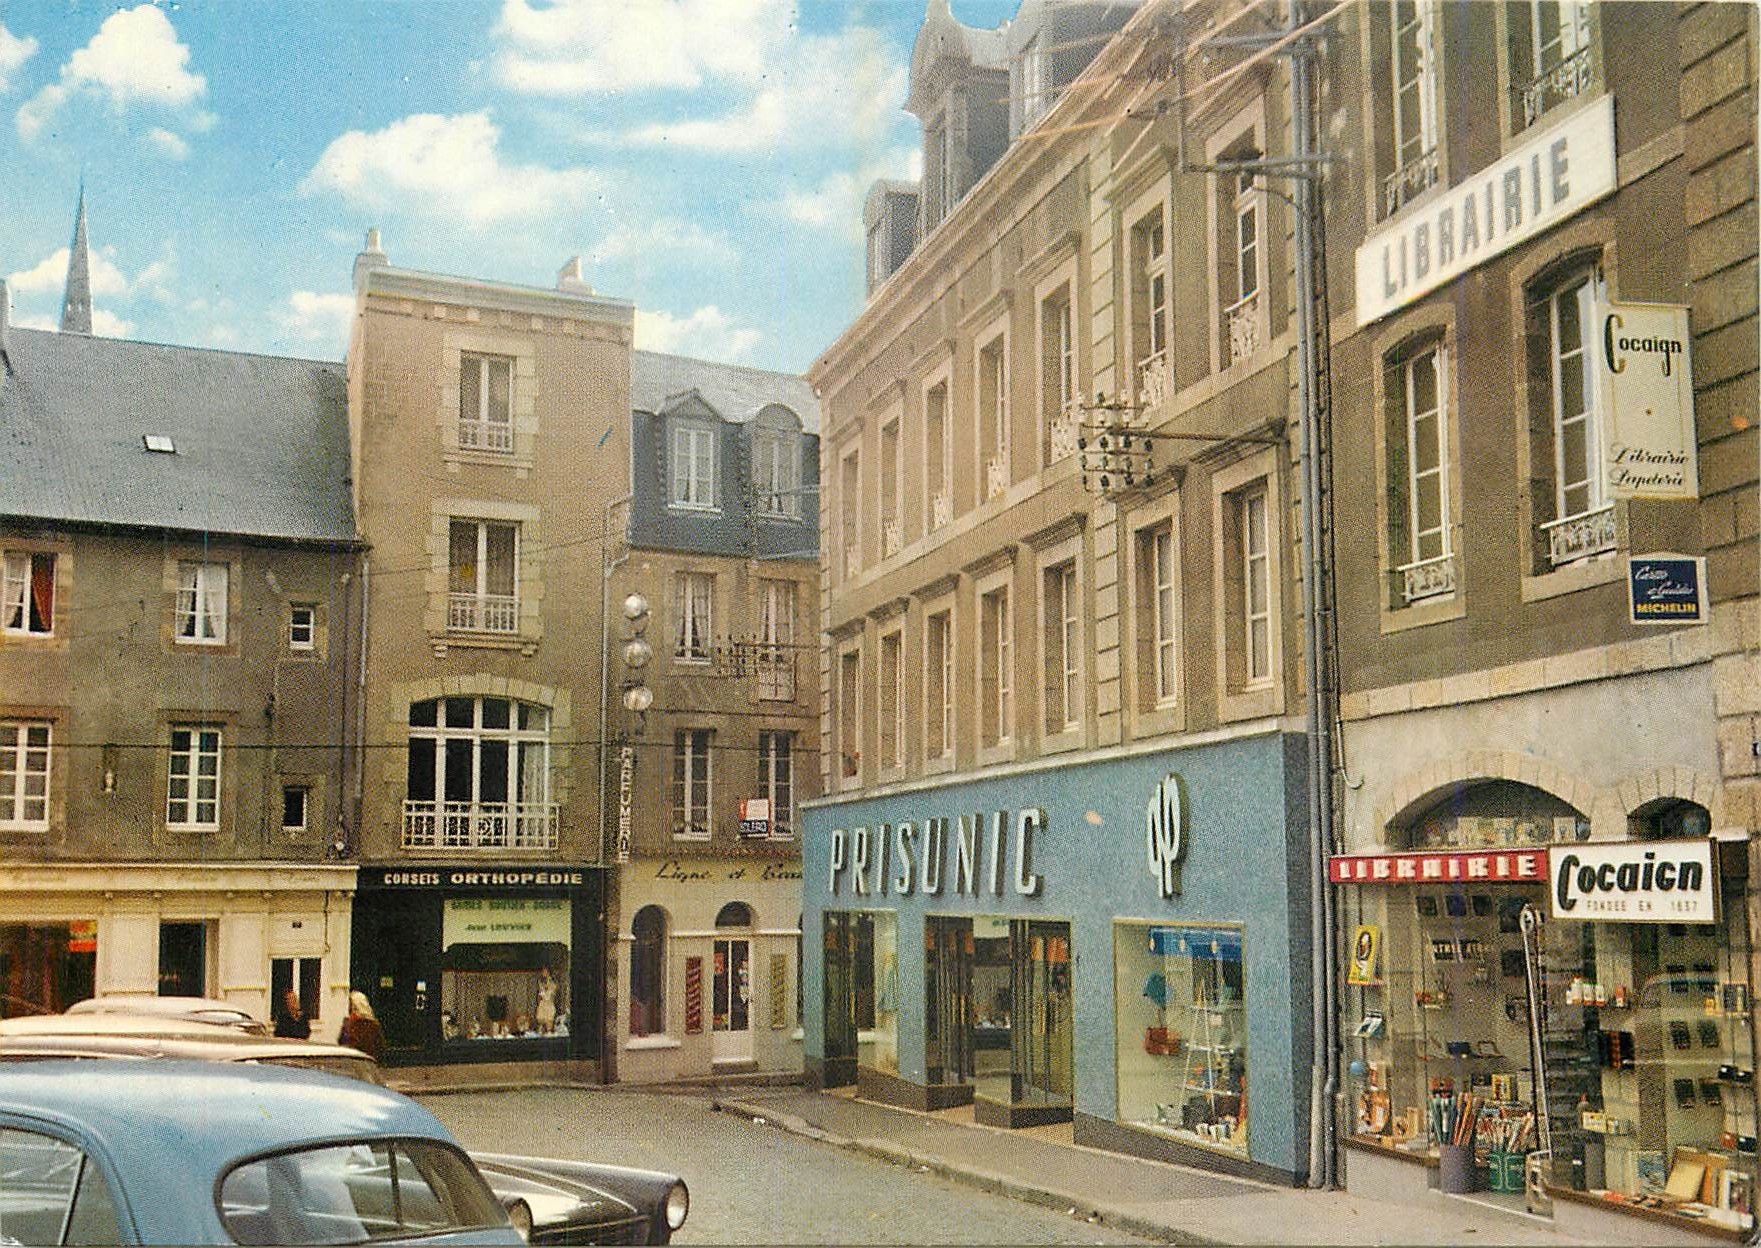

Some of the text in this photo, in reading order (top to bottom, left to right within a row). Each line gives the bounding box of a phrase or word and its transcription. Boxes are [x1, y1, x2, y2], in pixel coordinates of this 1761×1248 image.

[1383, 137, 1569, 299] LIBRAIRIE
[1605, 314, 1681, 377] Cocaign
[1610, 442, 1688, 464] Librairie
[1637, 603, 1696, 613] MICHELIN
[619, 747, 632, 862] PARFUMERIE
[829, 808, 1043, 894] PRISUNIC
[384, 873, 440, 885] CORSETS
[655, 860, 712, 883] Ligne
[729, 868, 746, 881] et
[1339, 855, 1537, 879] LIBRAIRIE
